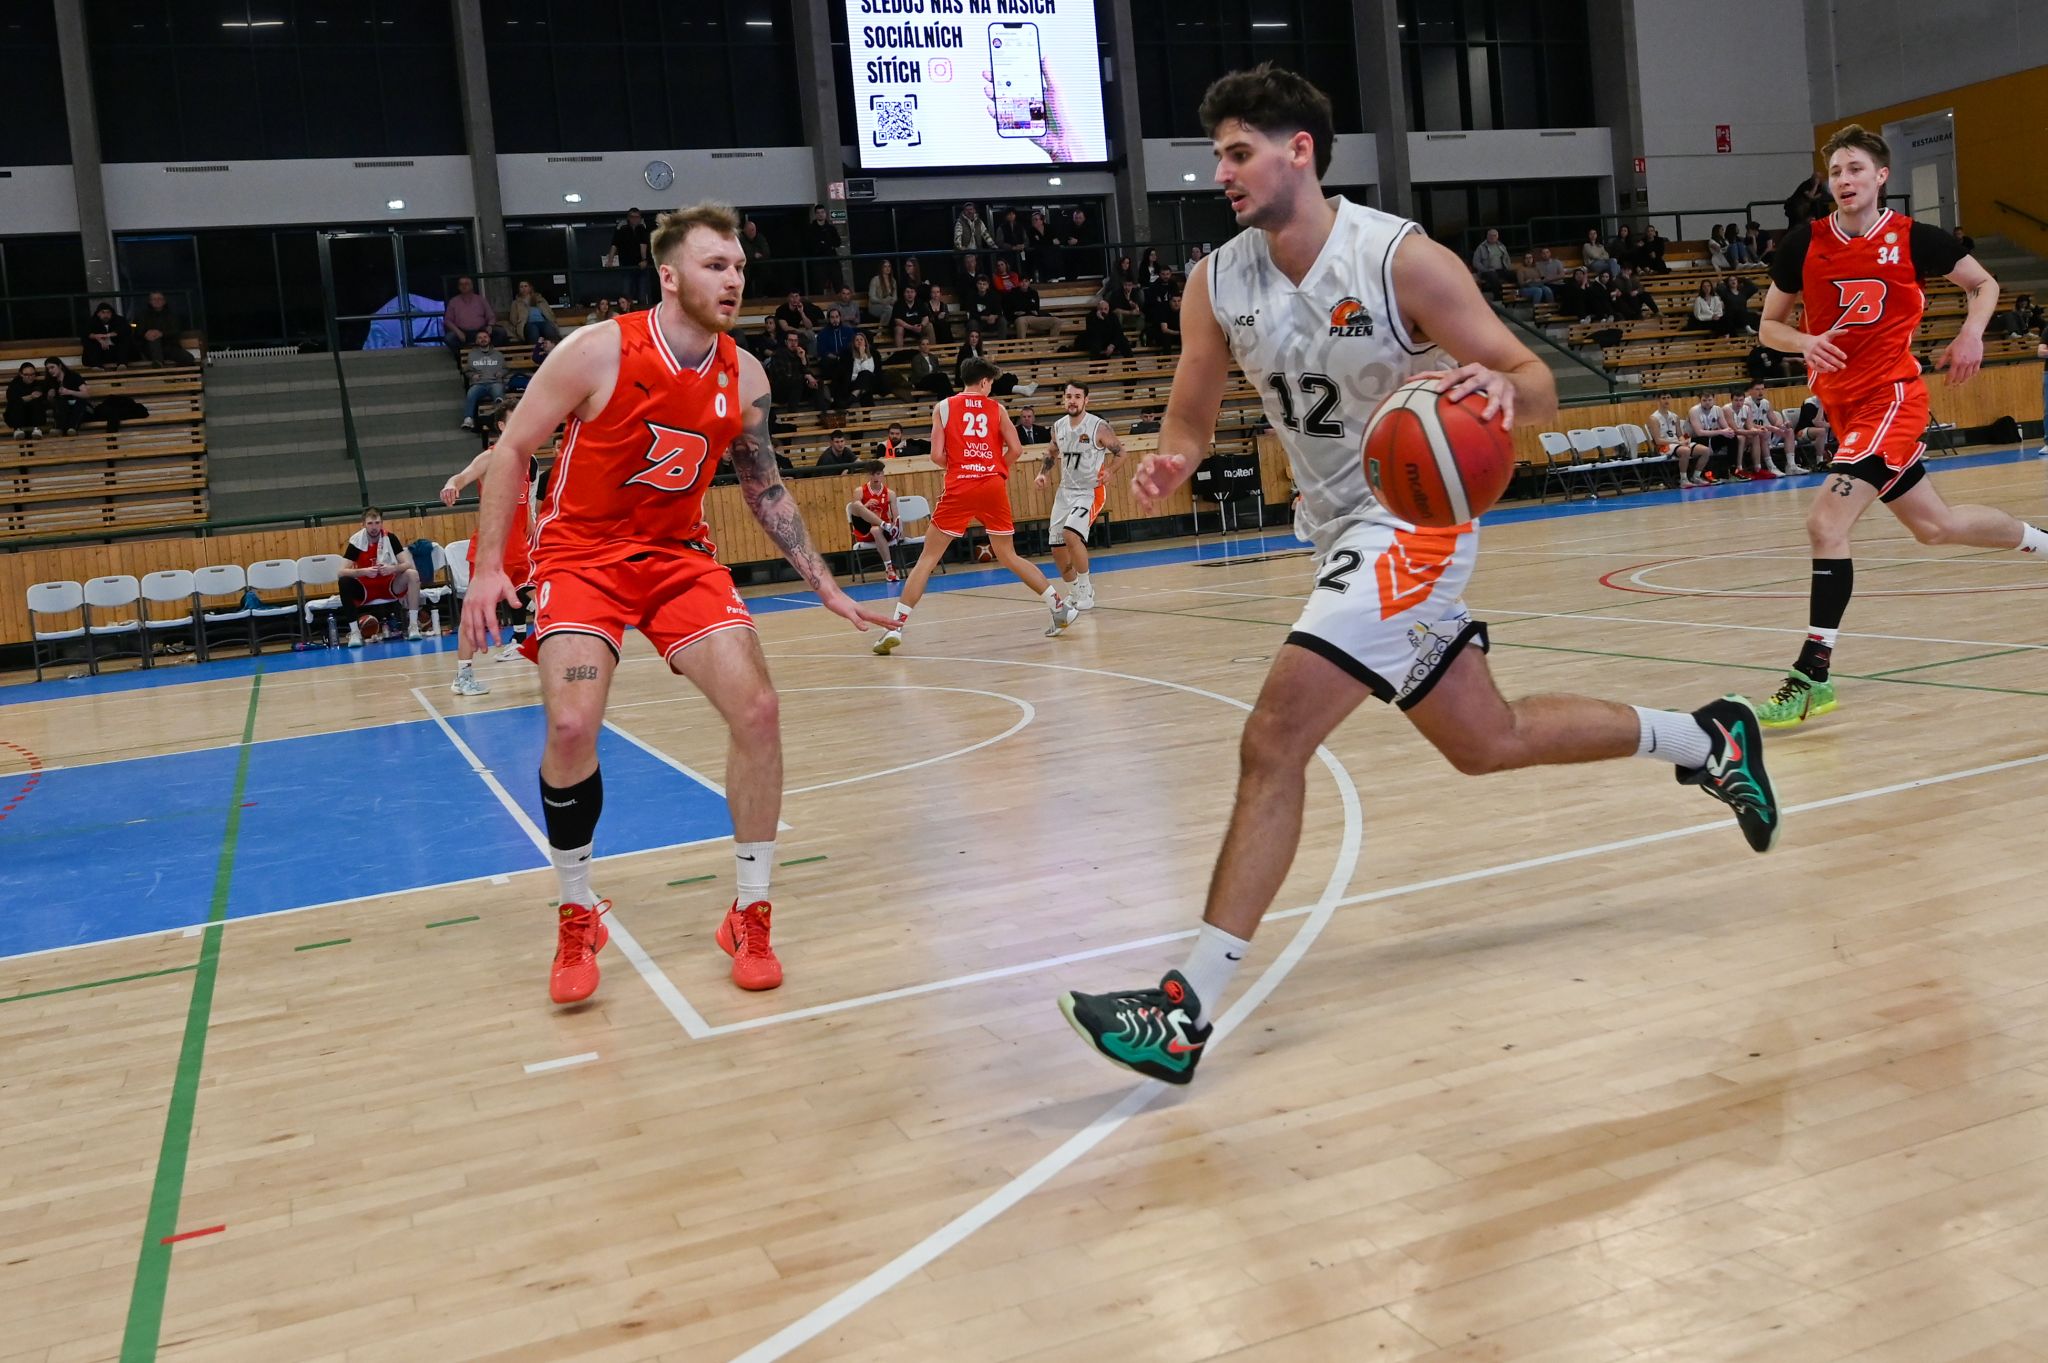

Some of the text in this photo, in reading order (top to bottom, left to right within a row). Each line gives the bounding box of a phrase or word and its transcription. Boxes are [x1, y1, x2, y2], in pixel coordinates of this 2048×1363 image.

[861, 0, 924, 14] SLEDUJ
[970, 0, 992, 14] NA
[863, 20, 963, 48] SOCIÁLNÍCH
[866, 55, 921, 83] SÍTÍCH
[1877, 246, 1899, 265] 34
[715, 392, 727, 418] 0
[1267, 372, 1345, 438] 12
[962, 412, 988, 438] 23
[963, 449, 993, 459] BOOKS
[966, 442, 989, 451] VIVID
[1063, 452, 1081, 470] 77
[1224, 468, 1254, 478] molten
[540, 580, 551, 609] 0
